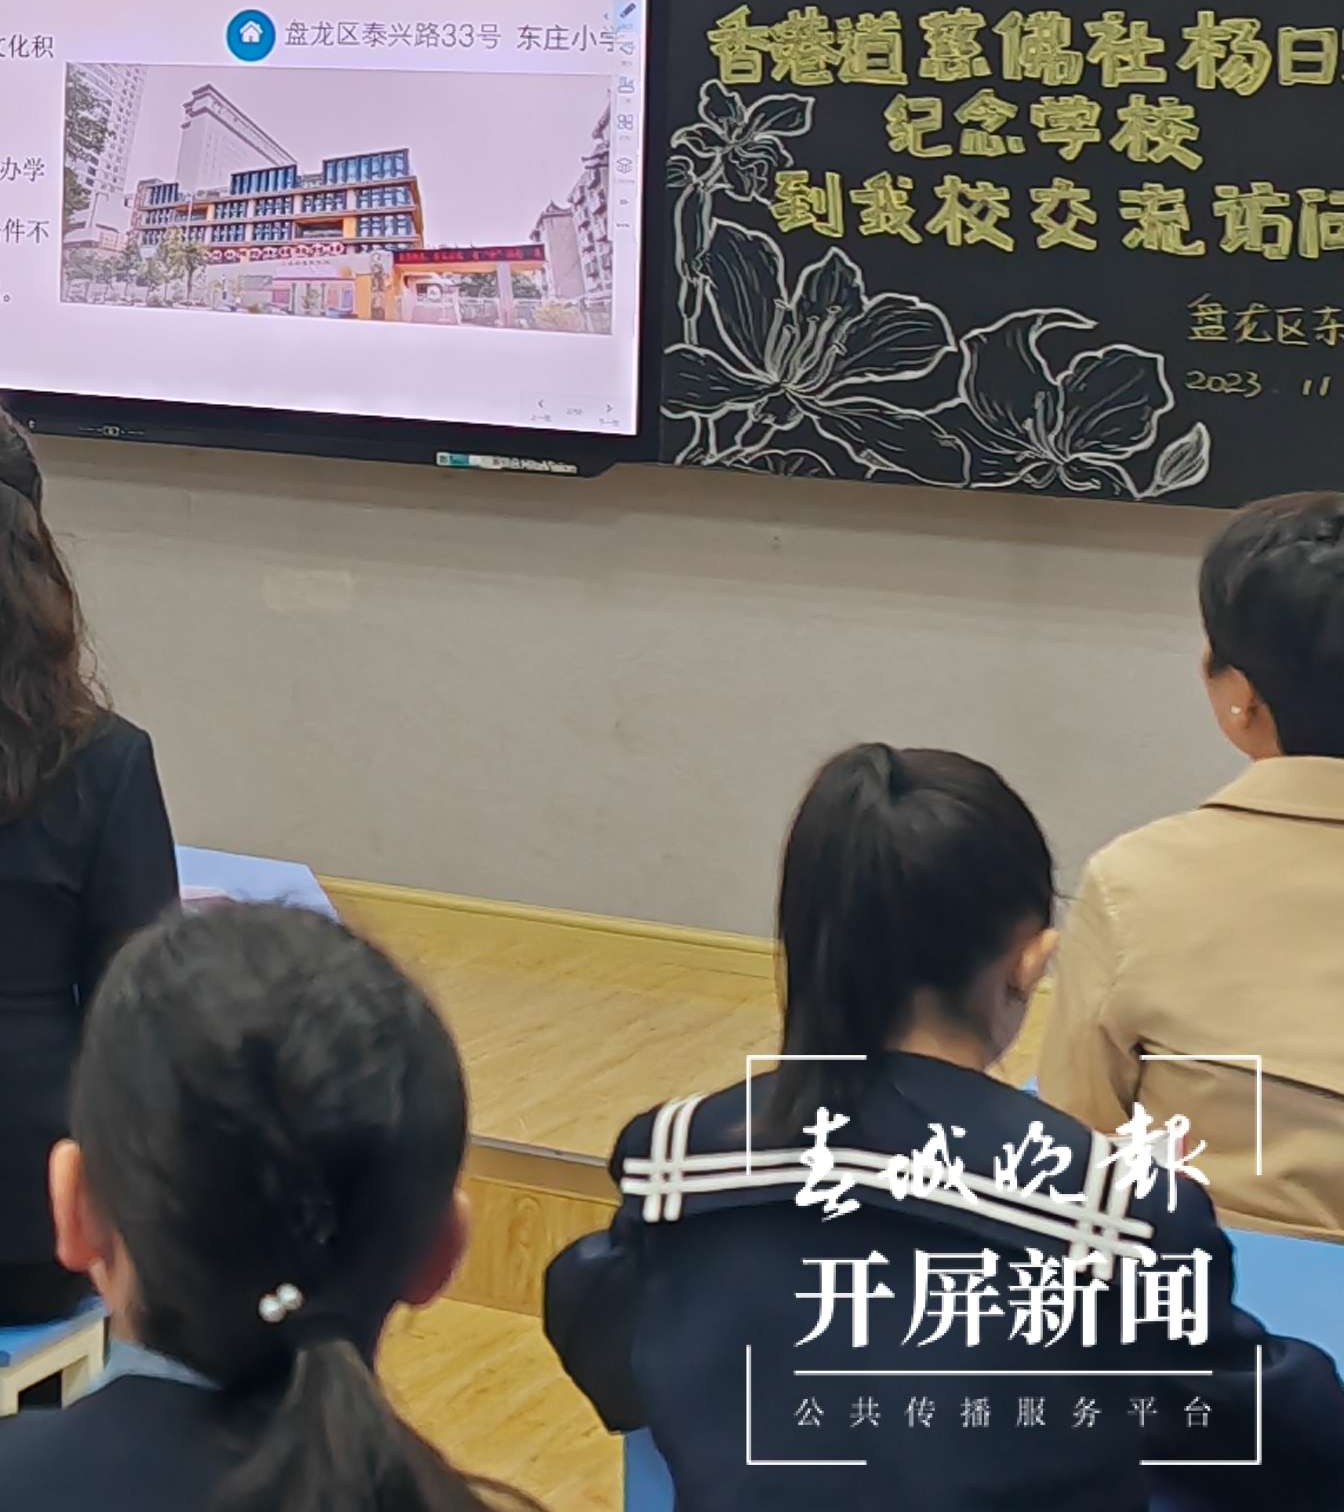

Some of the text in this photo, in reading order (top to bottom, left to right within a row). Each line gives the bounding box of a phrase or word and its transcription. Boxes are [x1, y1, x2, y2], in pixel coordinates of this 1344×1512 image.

[284, 19, 502, 49] 盘龙区泰兴路33号
[708, 4, 1344, 96] 香港道慈佛社杨日
[883, 89, 1204, 170] 纪念学校
[771, 170, 1344, 260] 到我校交流访问
[1187, 293, 1344, 346] 盘龙区东
[1185, 371, 1332, 398] 2023 11
